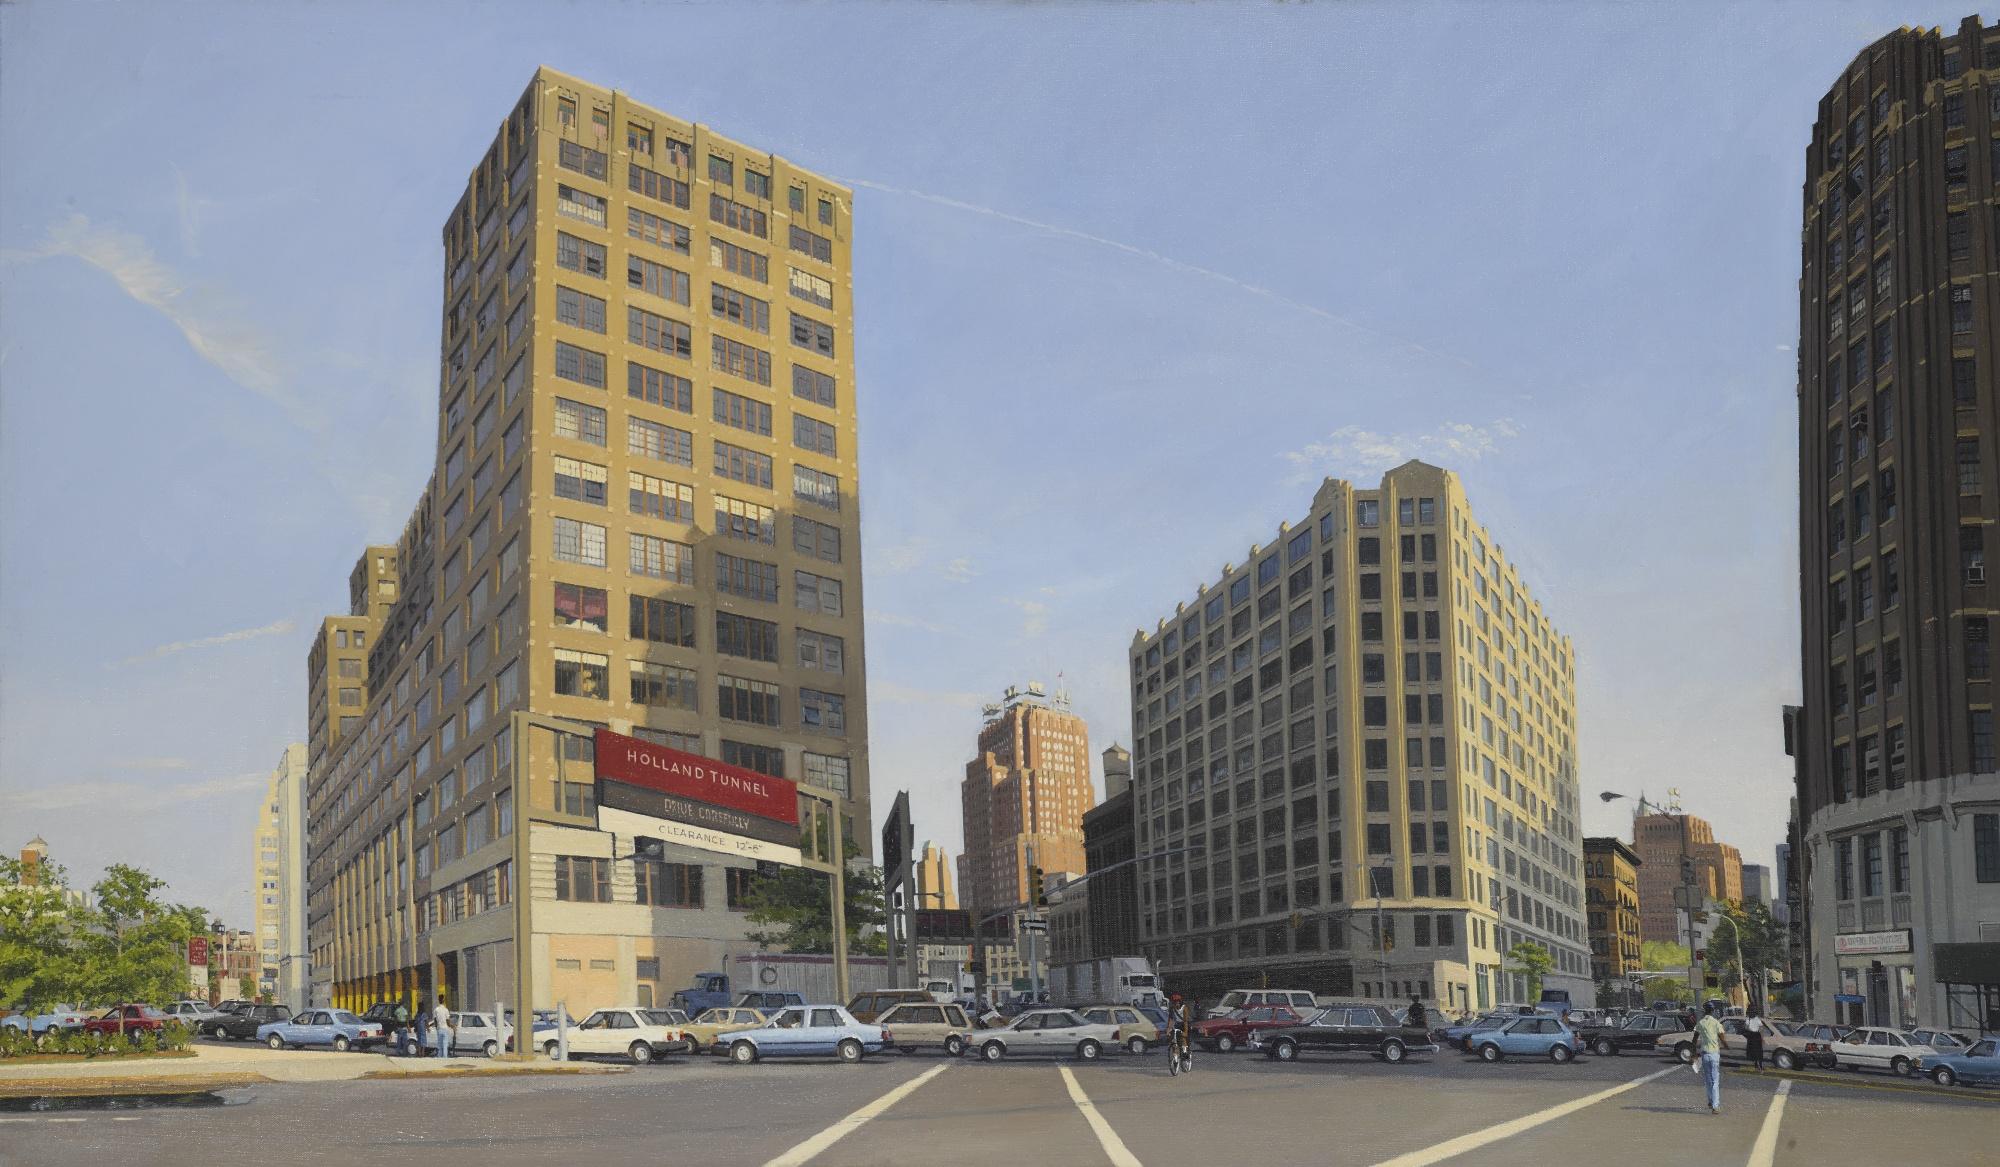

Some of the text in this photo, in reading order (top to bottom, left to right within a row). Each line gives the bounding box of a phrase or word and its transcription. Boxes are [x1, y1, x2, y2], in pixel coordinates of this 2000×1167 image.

[627, 750, 769, 797] HOLLAND TUNNEL
[664, 798, 693, 817] DRIVE
[658, 825, 726, 846] CLEARANCE
